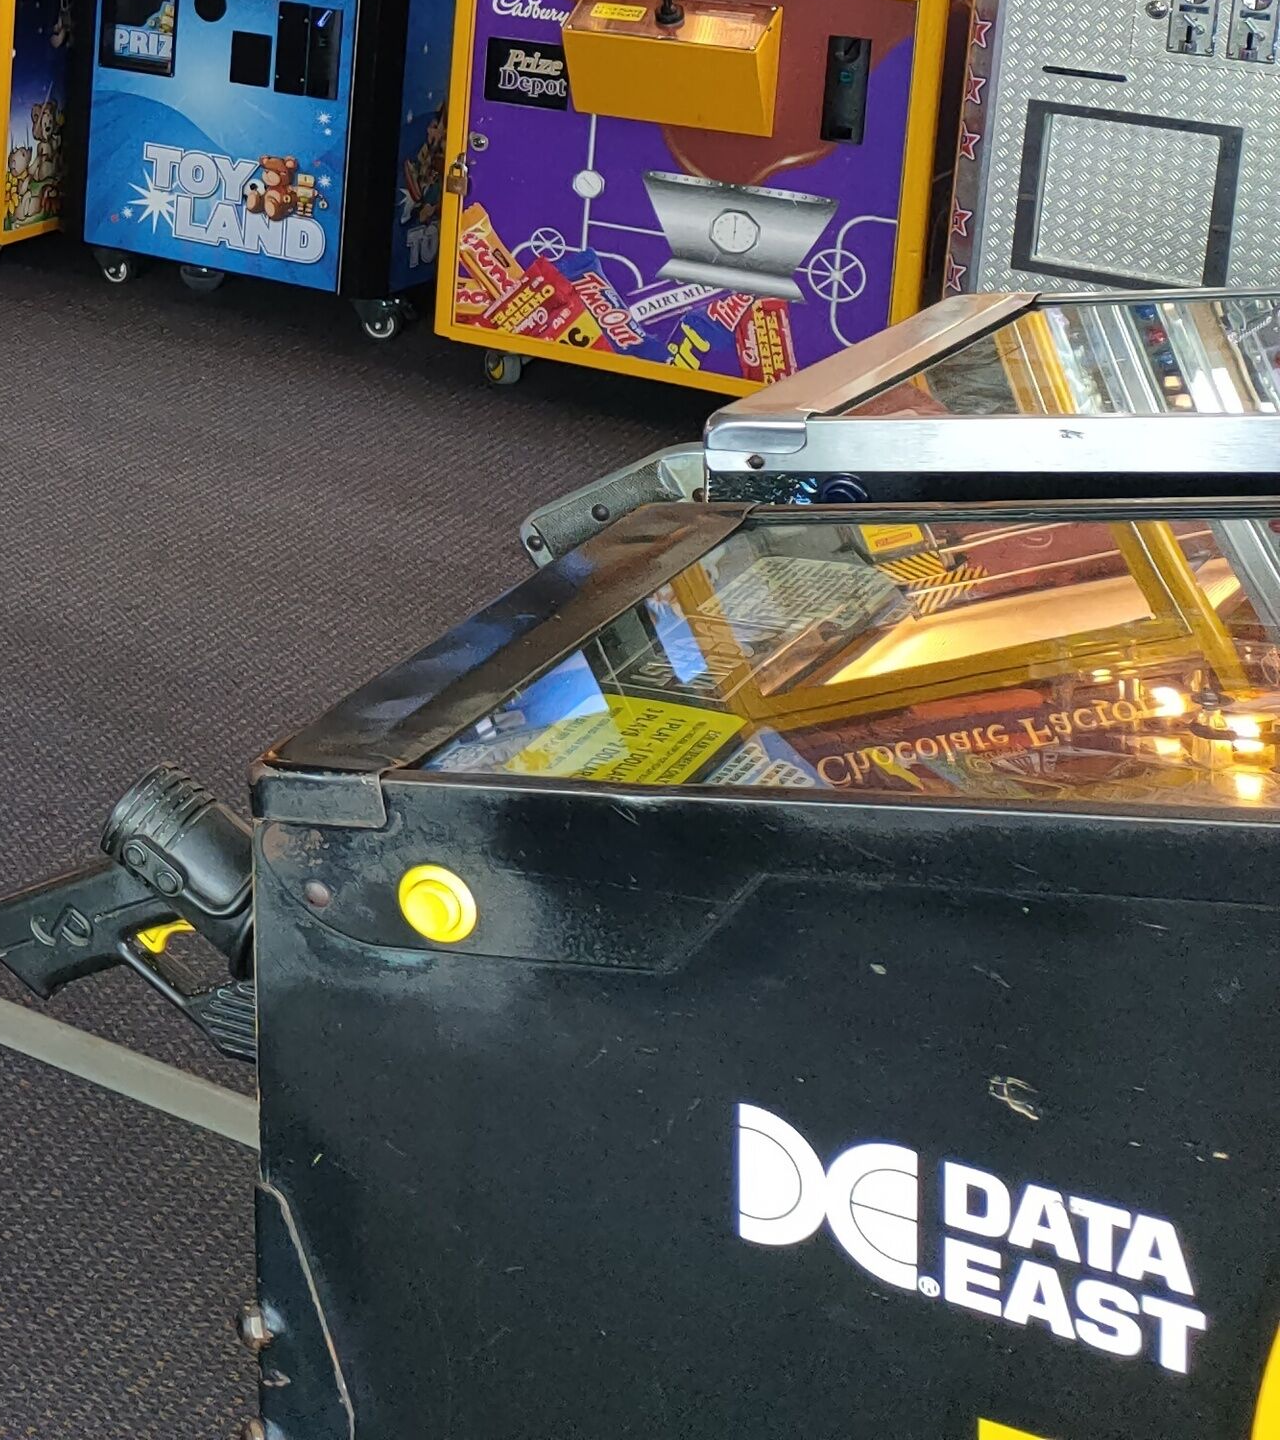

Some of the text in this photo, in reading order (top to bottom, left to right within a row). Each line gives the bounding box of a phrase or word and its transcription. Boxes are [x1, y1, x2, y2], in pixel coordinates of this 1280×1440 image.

[114, 27, 172, 58] PRIZ
[505, 48, 564, 76] Prize
[498, 66, 568, 98] Depot
[143, 141, 261, 204] TOY
[172, 193, 326, 264] LAND
[406, 223, 439, 269] TO
[636, 284, 715, 316] DAIRY MIL
[943, 1160, 1196, 1297] DATA
[943, 1236, 1207, 1375] EAST
